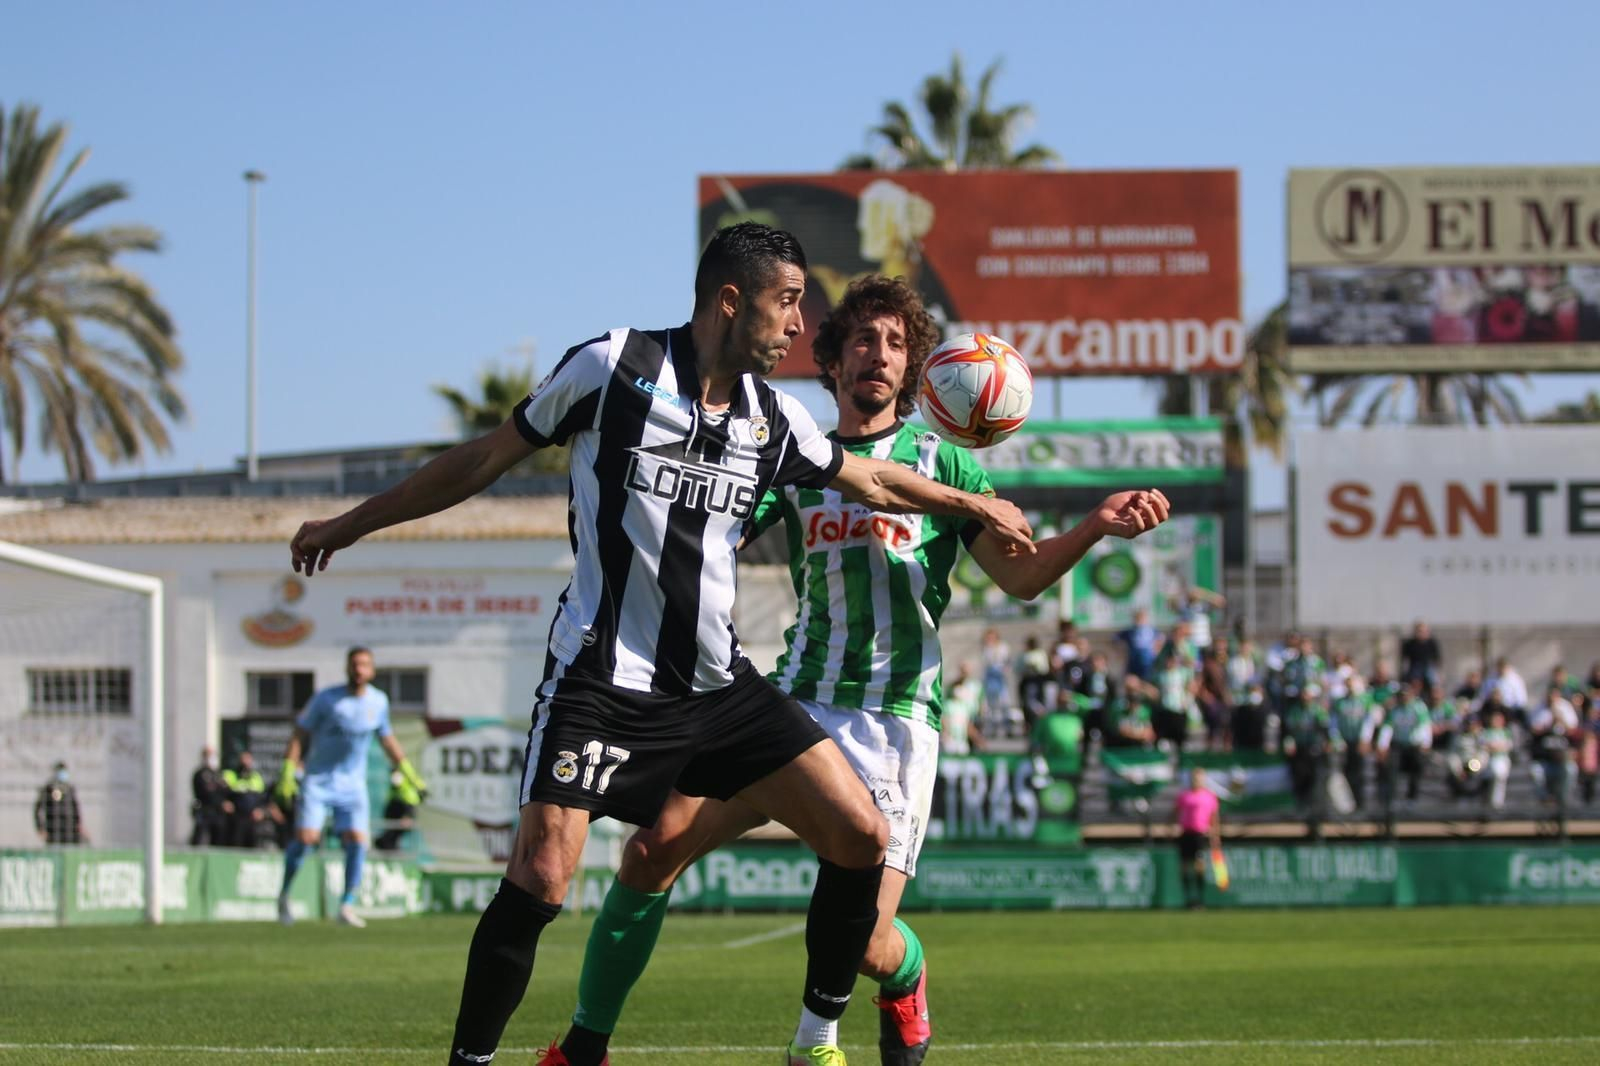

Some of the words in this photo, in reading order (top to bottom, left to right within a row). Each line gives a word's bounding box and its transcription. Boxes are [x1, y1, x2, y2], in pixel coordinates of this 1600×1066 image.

[1426, 199, 1494, 251] El
[634, 377, 682, 407] LEGEA
[624, 454, 756, 521] LOTUS
[438, 596, 466, 614] DE
[582, 739, 631, 794] 17
[926, 757, 1039, 839] TRAS
